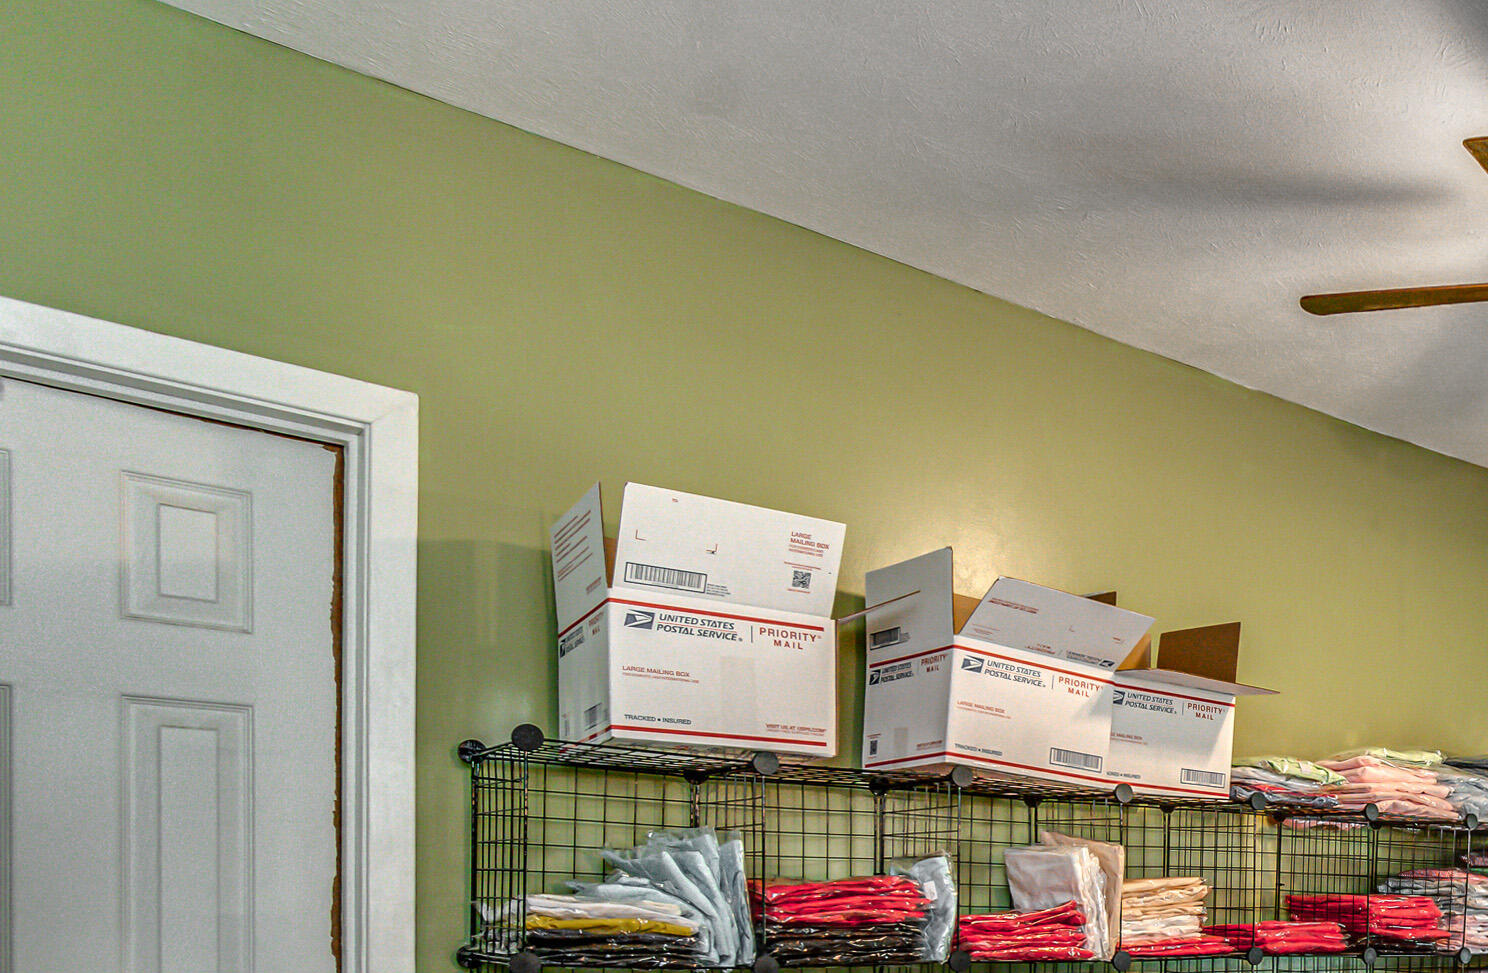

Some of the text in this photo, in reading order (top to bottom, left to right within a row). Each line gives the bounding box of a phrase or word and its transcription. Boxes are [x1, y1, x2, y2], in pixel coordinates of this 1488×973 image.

[659, 613, 736, 631] UNITED STATES
[656, 623, 738, 642] POSTAL SERVICE
[759, 627, 817, 643] PRIORITY
[773, 640, 804, 650] MAIL
[622, 665, 645, 673] LARGE
[646, 667, 675, 676] MAILING
[986, 659, 1042, 678] UNITED STATES
[983, 668, 1043, 688] POSTAL SERVICE
[1058, 676, 1101, 692] PRIORITY
[1068, 688, 1090, 698] MAIL
[1127, 692, 1173, 706] UNITED STATES
[1124, 700, 1175, 715] POSTAL SERVICE
[1187, 702, 1223, 715] PRIORITY
[624, 714, 692, 725] TRACKED INSURED
[1195, 711, 1215, 721] MAIL
